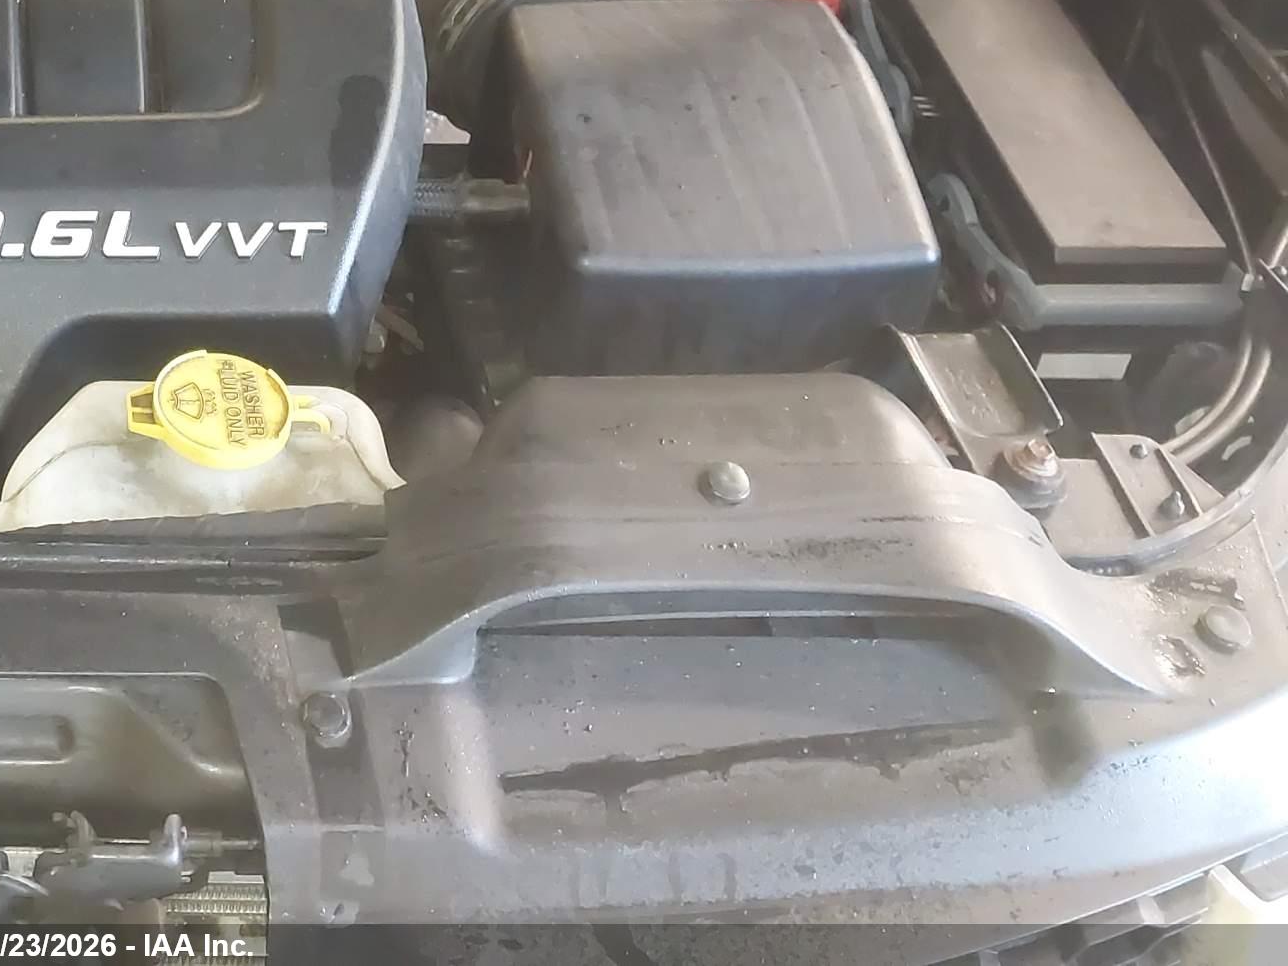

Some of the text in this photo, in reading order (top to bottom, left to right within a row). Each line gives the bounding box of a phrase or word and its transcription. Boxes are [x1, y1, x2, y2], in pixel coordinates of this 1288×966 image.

[173, 221, 328, 261] VVT
[217, 359, 247, 446] FLUID ONLY
[238, 370, 266, 439] WASHER
